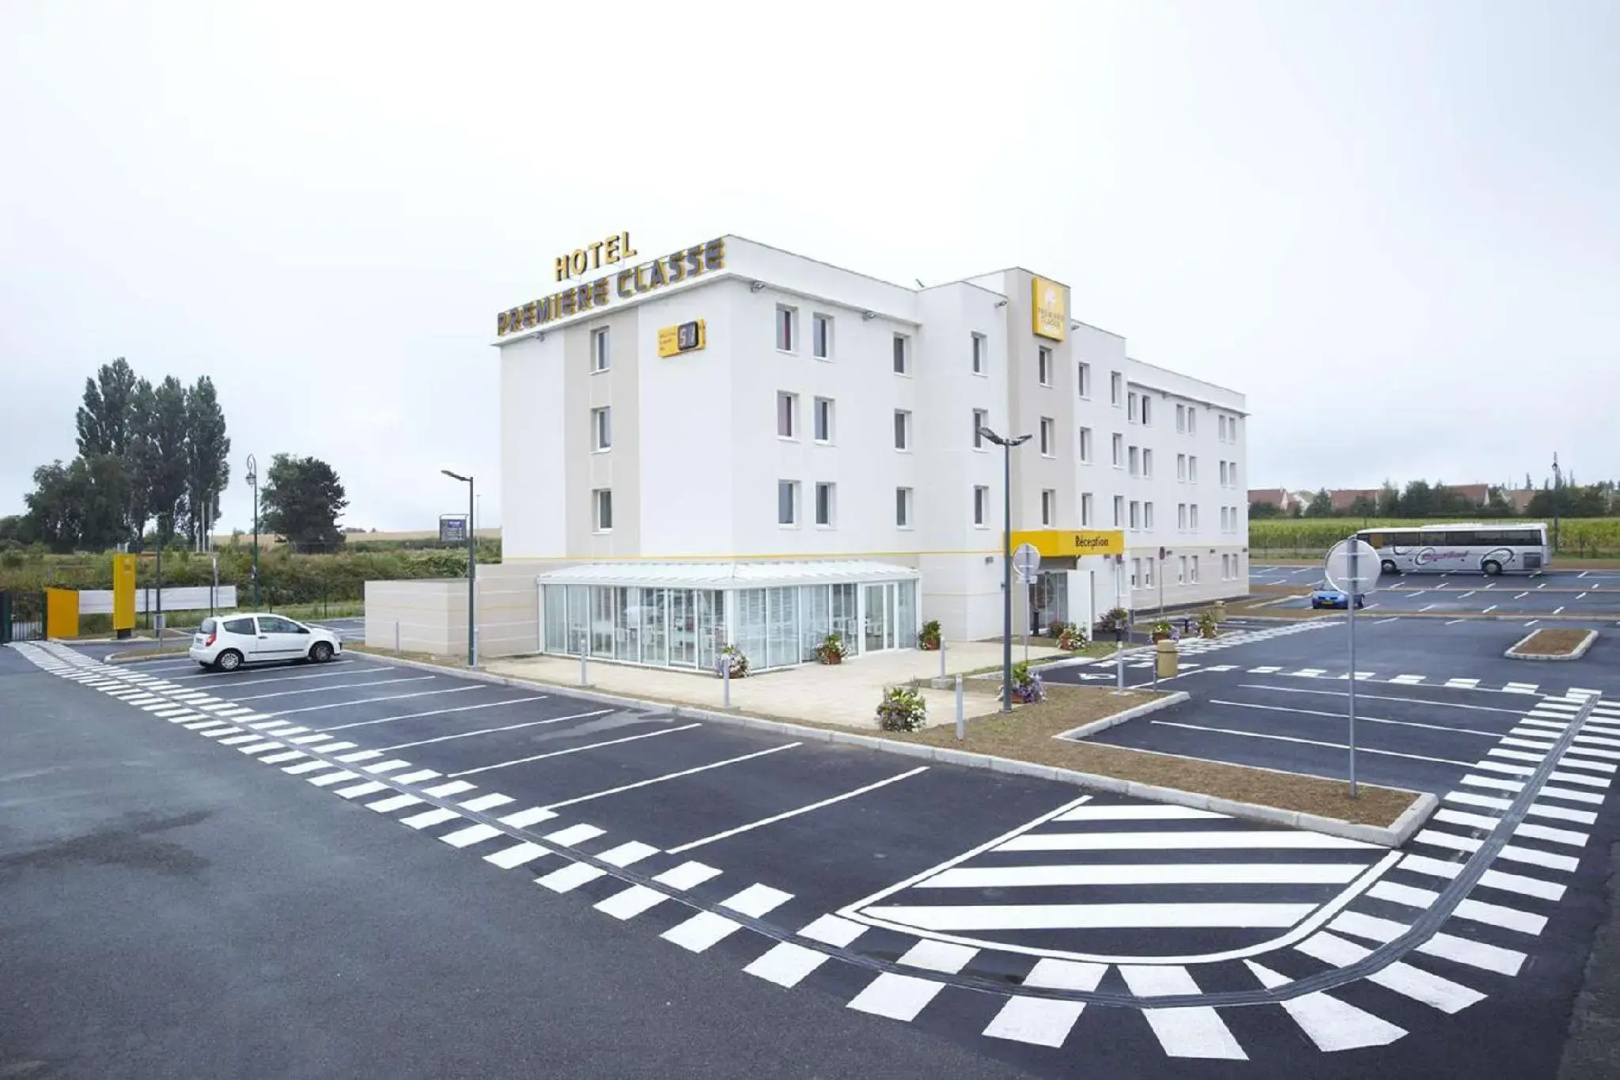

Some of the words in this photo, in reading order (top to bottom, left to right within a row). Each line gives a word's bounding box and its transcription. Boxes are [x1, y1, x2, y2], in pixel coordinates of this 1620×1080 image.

[555, 231, 637, 282] HOTEL
[497, 277, 609, 337] PREMIERE
[617, 238, 725, 298] CLASSE
[1075, 535, 1109, 550] Réception
